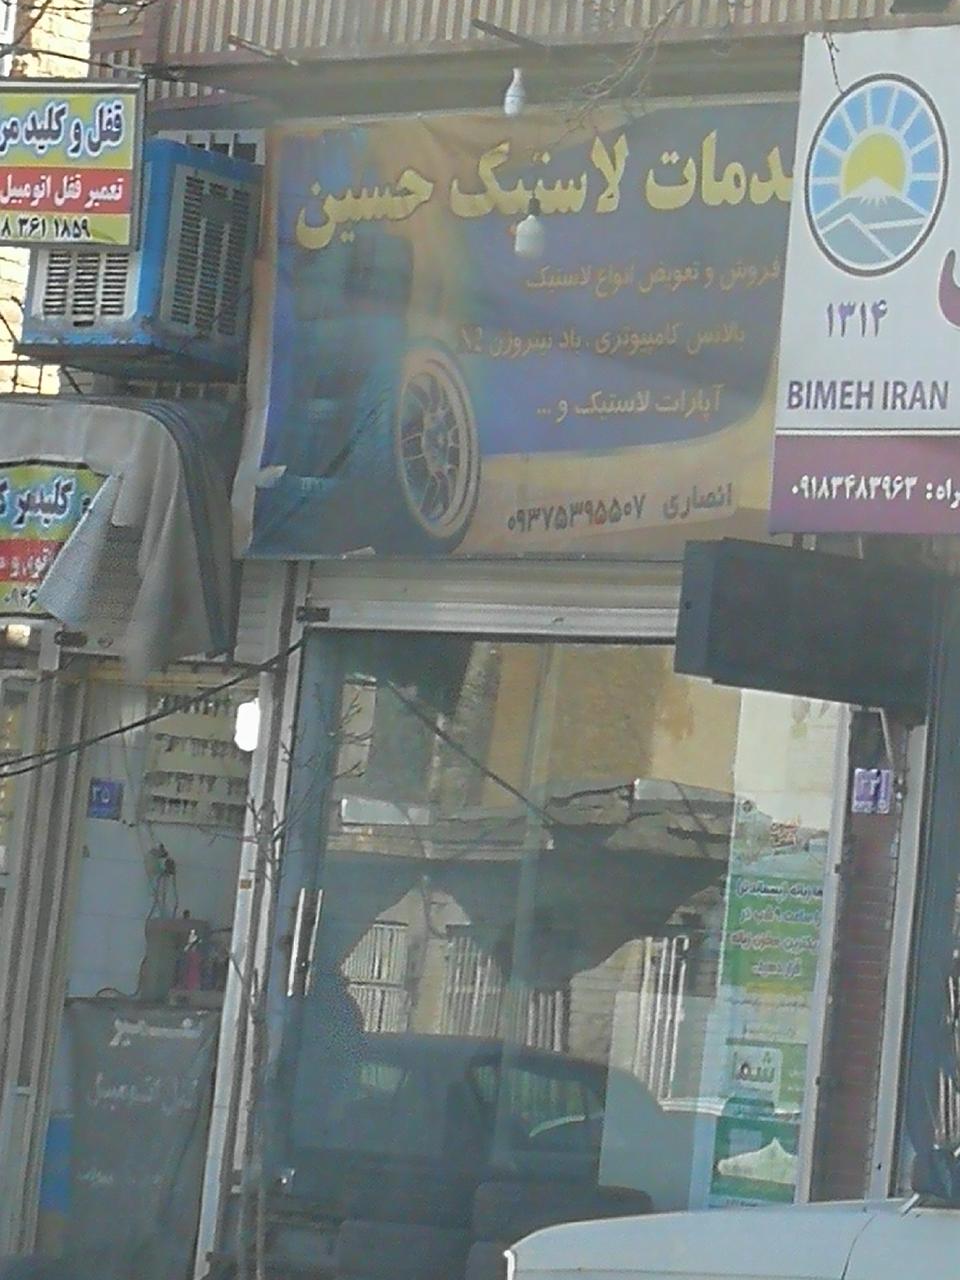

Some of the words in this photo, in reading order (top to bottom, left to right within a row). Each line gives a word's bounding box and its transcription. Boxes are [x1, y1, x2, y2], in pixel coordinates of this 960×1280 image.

[23, 102, 68, 154] کلید
[67, 120, 83, 157] و
[86, 102, 124, 156] قفل
[449, 133, 630, 221] لاستیک
[644, 128, 796, 210] دمات
[53, 173, 83, 207] قفل
[83, 177, 125, 209] تعمیر
[295, 168, 435, 251] حسین
[53, 217, 92, 239] ۱۸۵۹
[526, 265, 593, 294] لاستیک
[595, 265, 635, 299] انواع
[639, 266, 700, 294] تعویض
[824, 298, 889, 339] ۱۳۱۴
[575, 389, 650, 420] لاستیک
[788, 379, 876, 412] BIMEH
[881, 380, 950, 412] IRAN
[662, 481, 733, 520] انصاری
